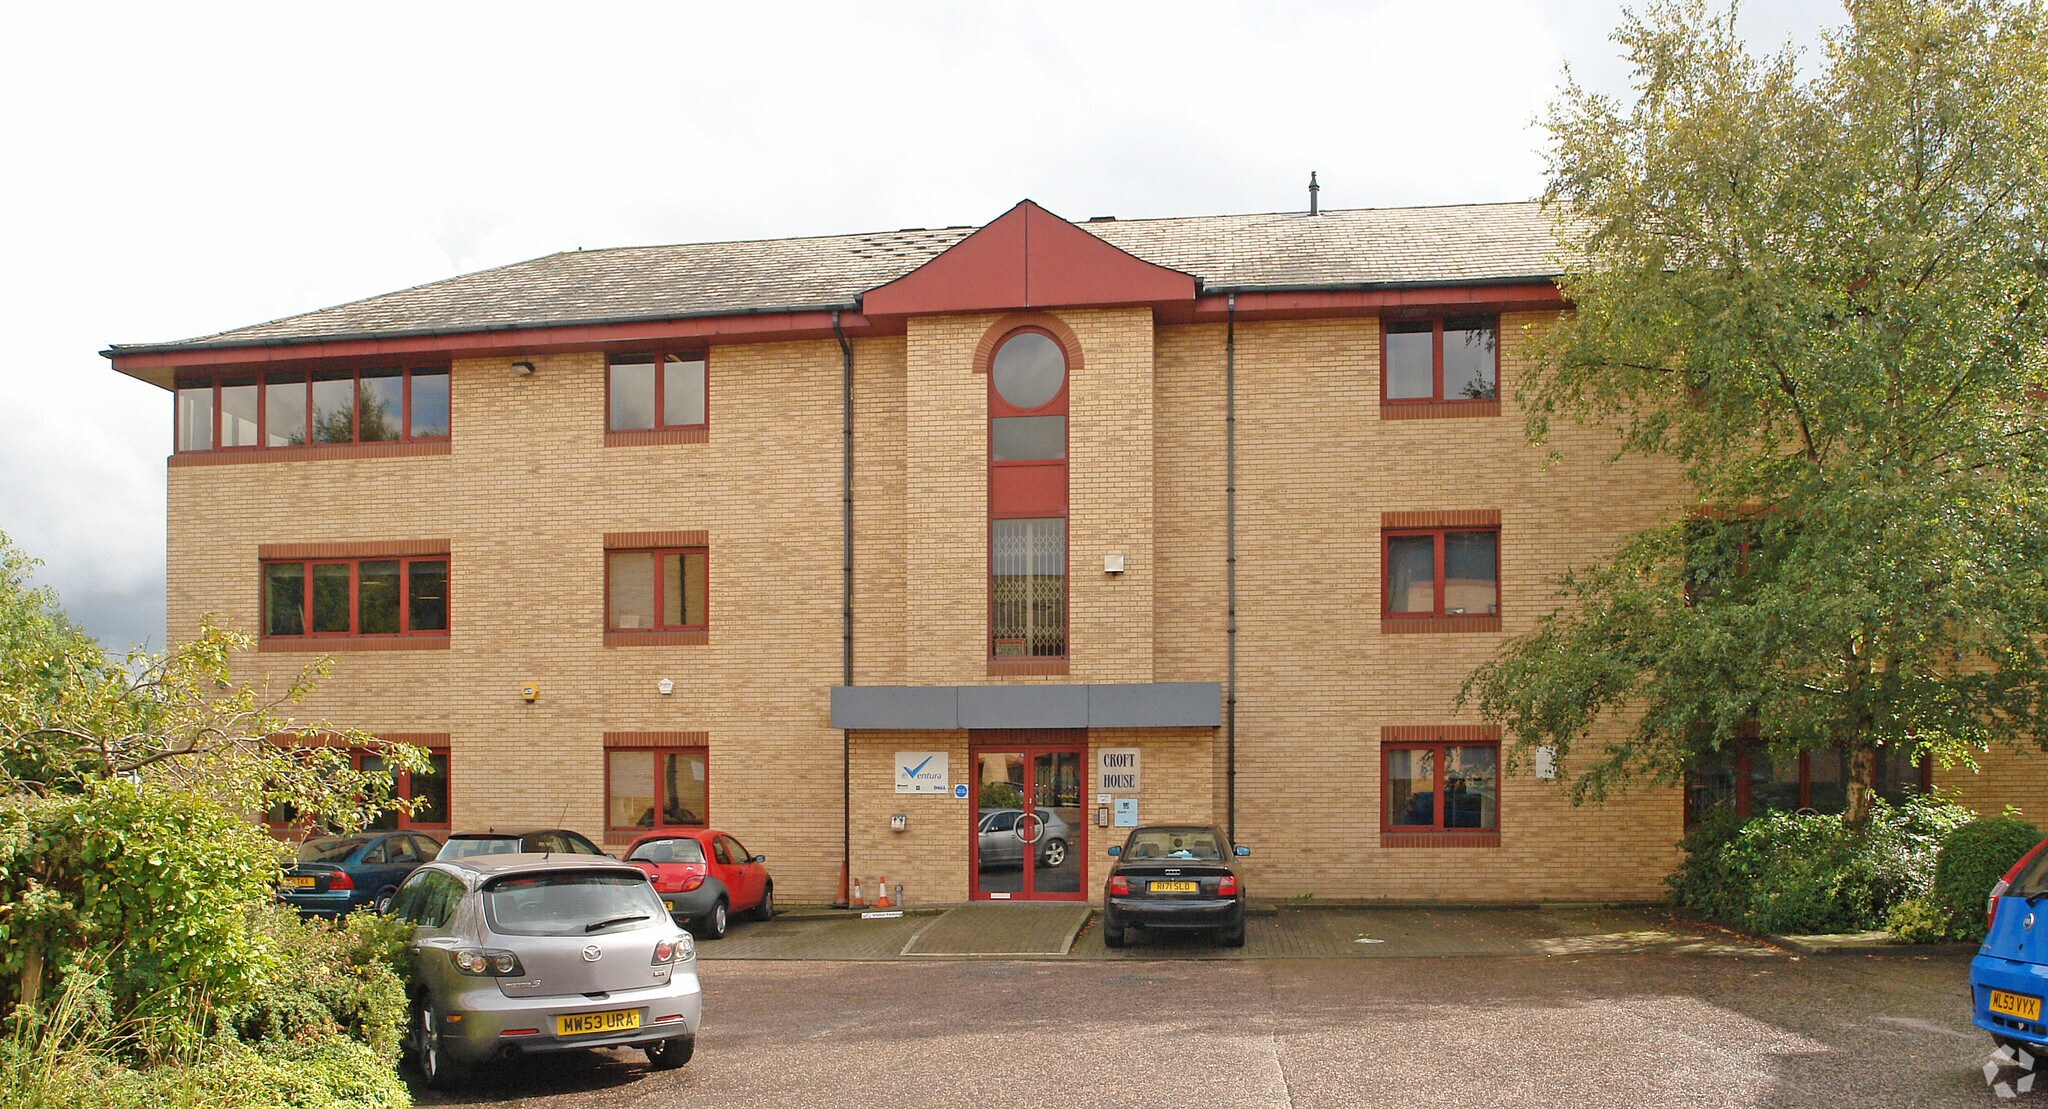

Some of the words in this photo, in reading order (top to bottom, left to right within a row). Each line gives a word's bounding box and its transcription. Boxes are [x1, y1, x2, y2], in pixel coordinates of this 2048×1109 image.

[1104, 753, 1135, 767] CROFT
[1103, 774, 1135, 788] HOUSE
[1993, 992, 2014, 1011] ML53
[2017, 997, 2036, 1016] VYX
[564, 1015, 602, 1032] MW53
[606, 1012, 633, 1028] URA
